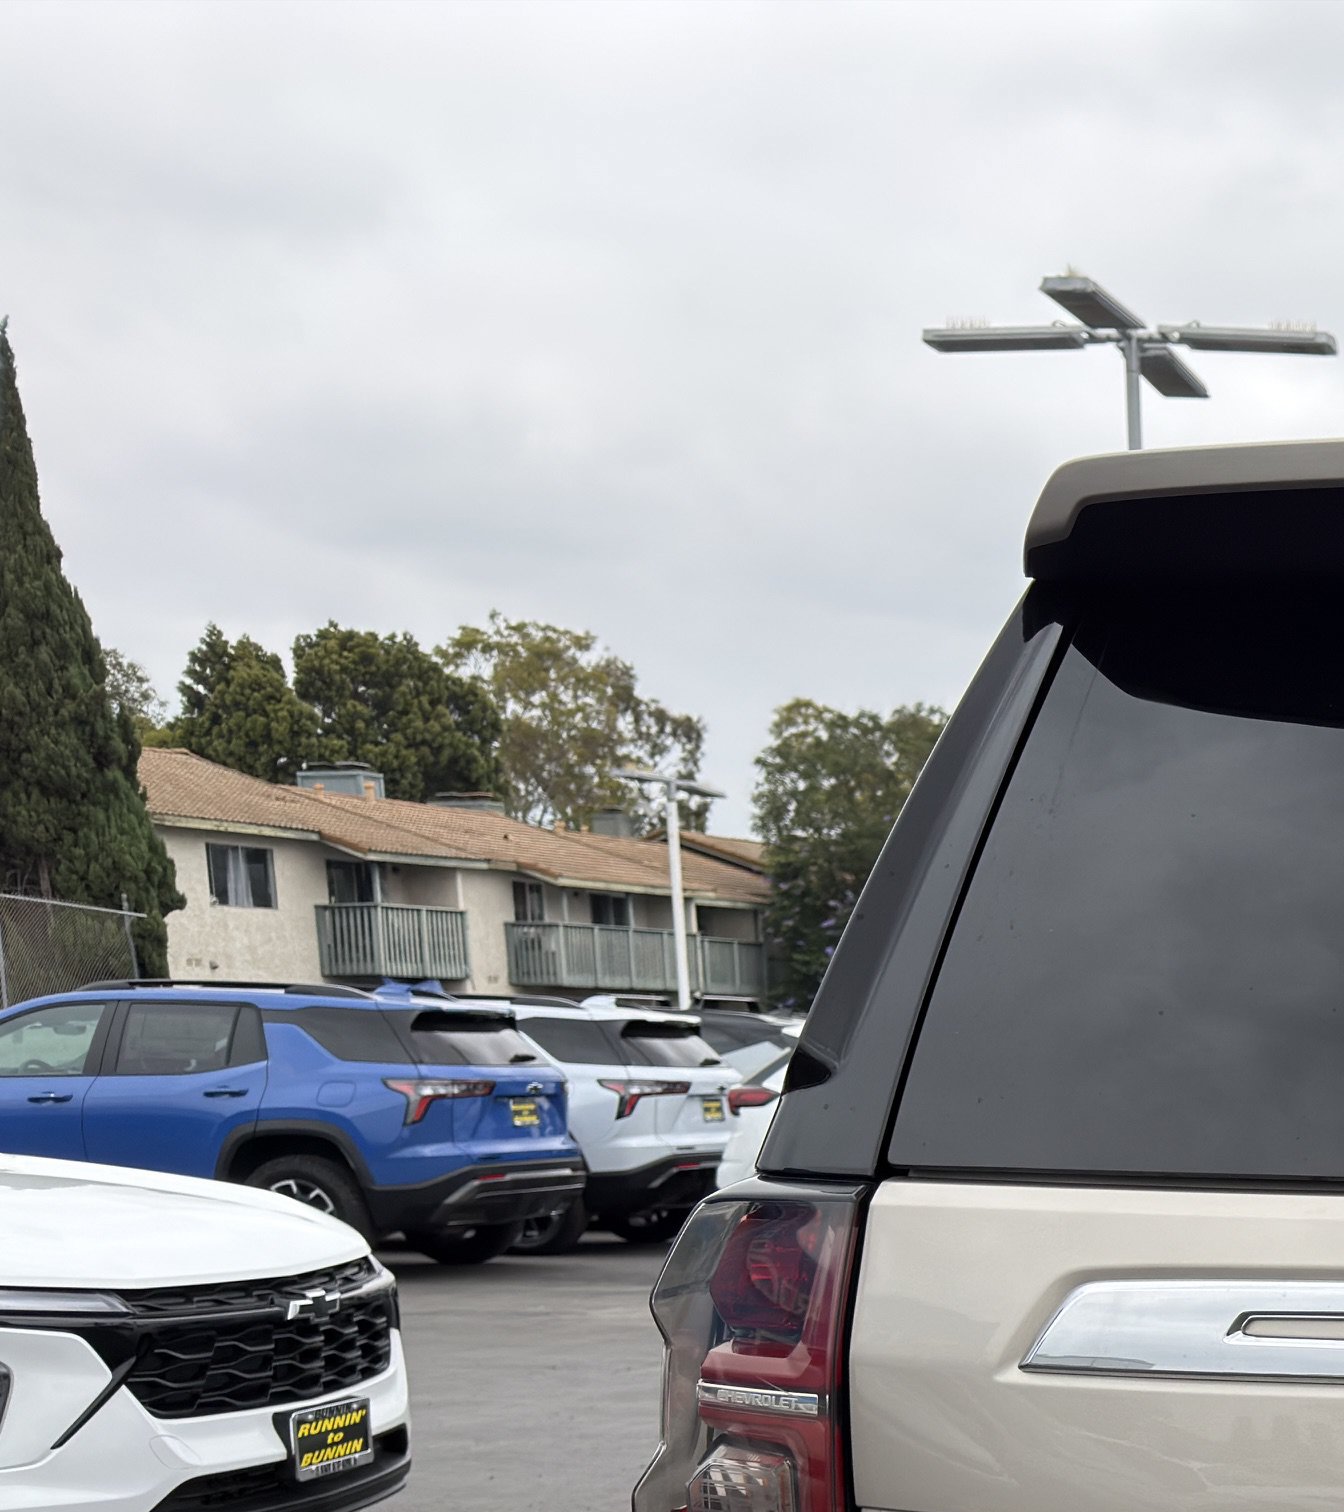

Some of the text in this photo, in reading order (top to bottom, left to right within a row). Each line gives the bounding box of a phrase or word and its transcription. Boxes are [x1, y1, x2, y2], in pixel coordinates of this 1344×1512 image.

[717, 1389, 799, 1410] CHEVROLET
[298, 1409, 367, 1439] RUNNIN'
[326, 1432, 344, 1445] to
[301, 1437, 364, 1468] BUNNIN
